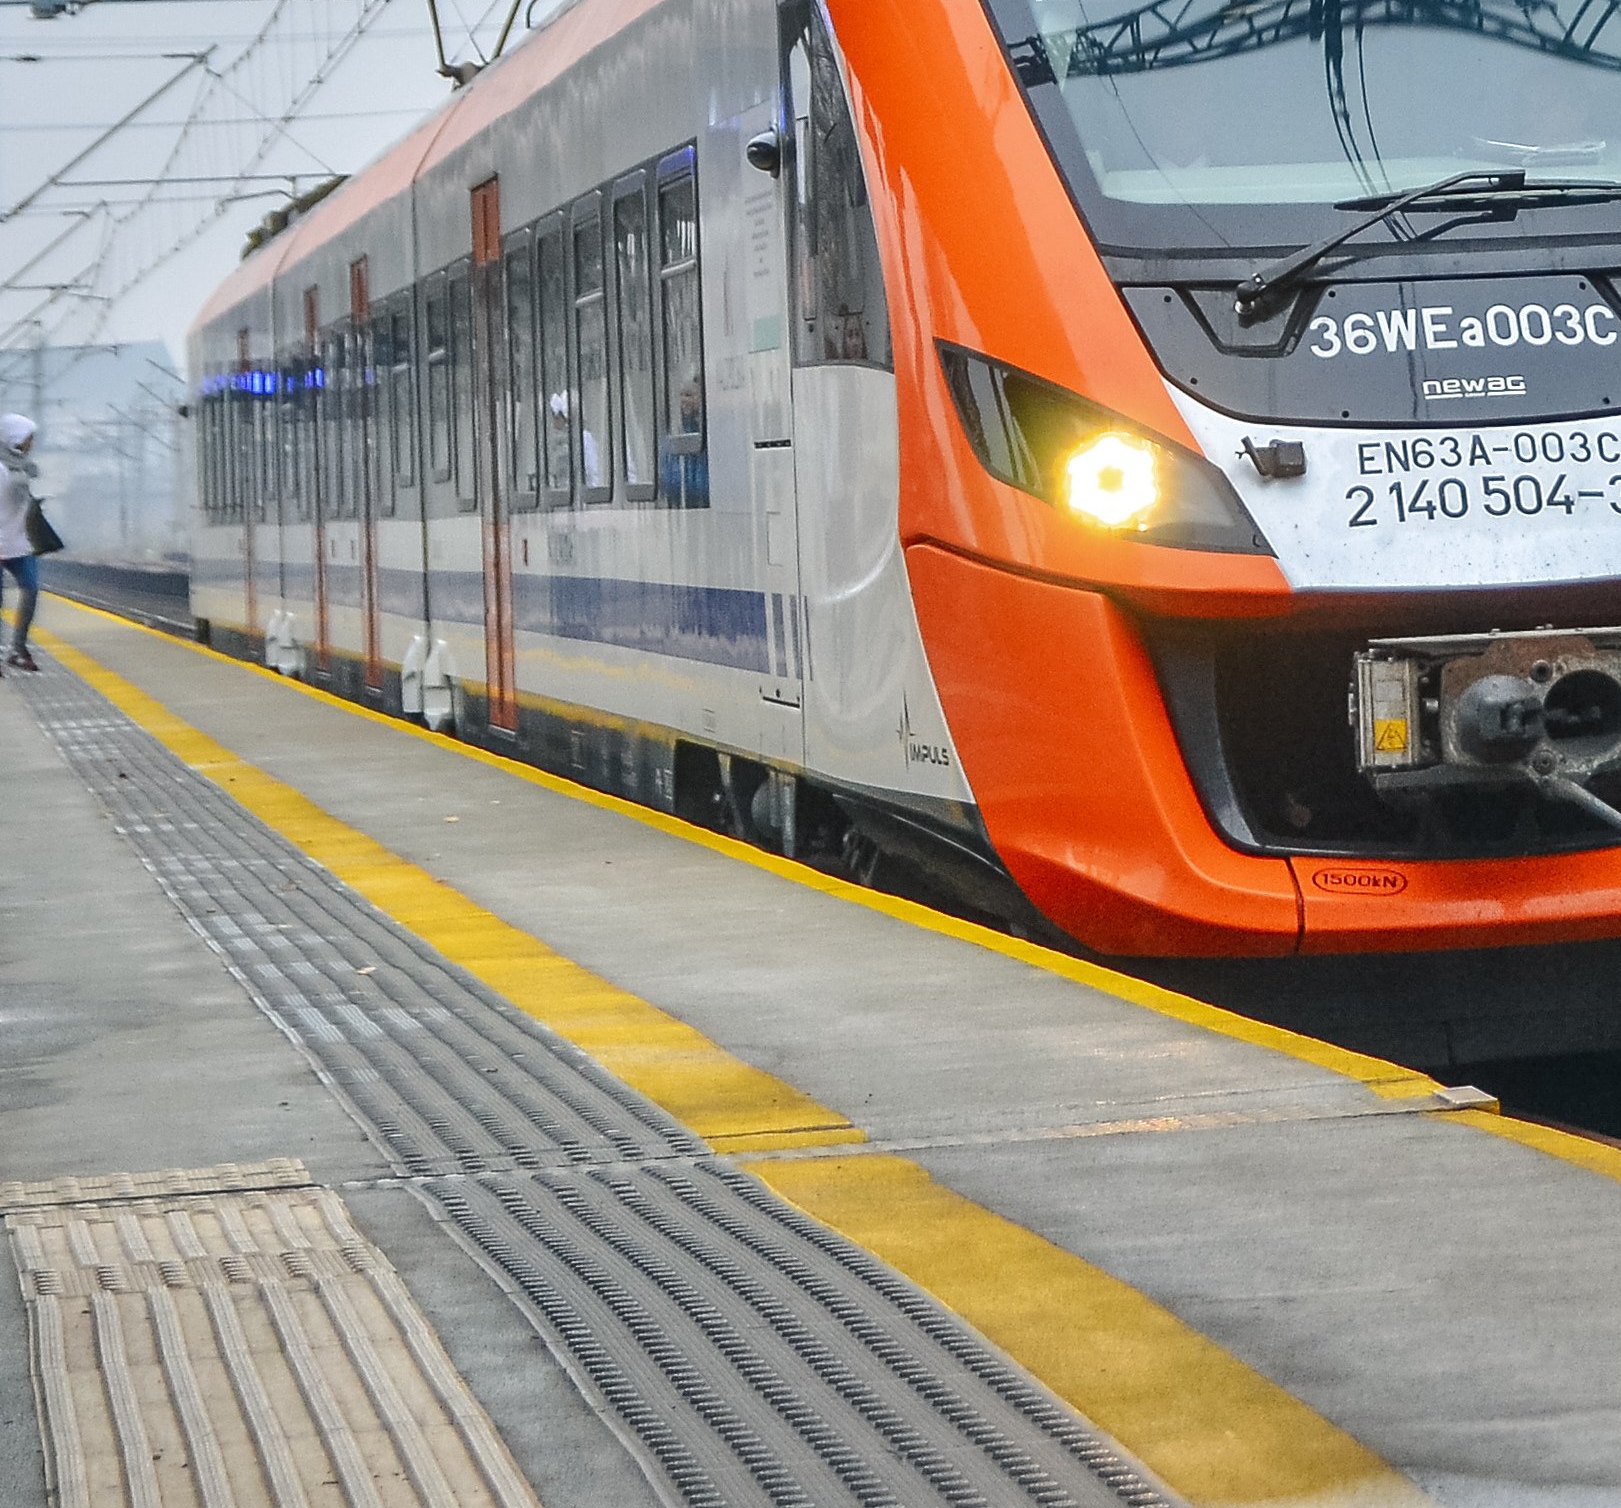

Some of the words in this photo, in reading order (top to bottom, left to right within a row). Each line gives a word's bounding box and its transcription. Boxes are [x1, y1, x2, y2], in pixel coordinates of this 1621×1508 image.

[1309, 303, 1618, 359] 36WEa003C
[1357, 431, 1621, 476] EN63A-003C
[1345, 485, 1378, 528] 2
[1388, 477, 1469, 524] 140
[909, 742, 950, 767] IMPULS
[1322, 873, 1398, 889] 1500kN
